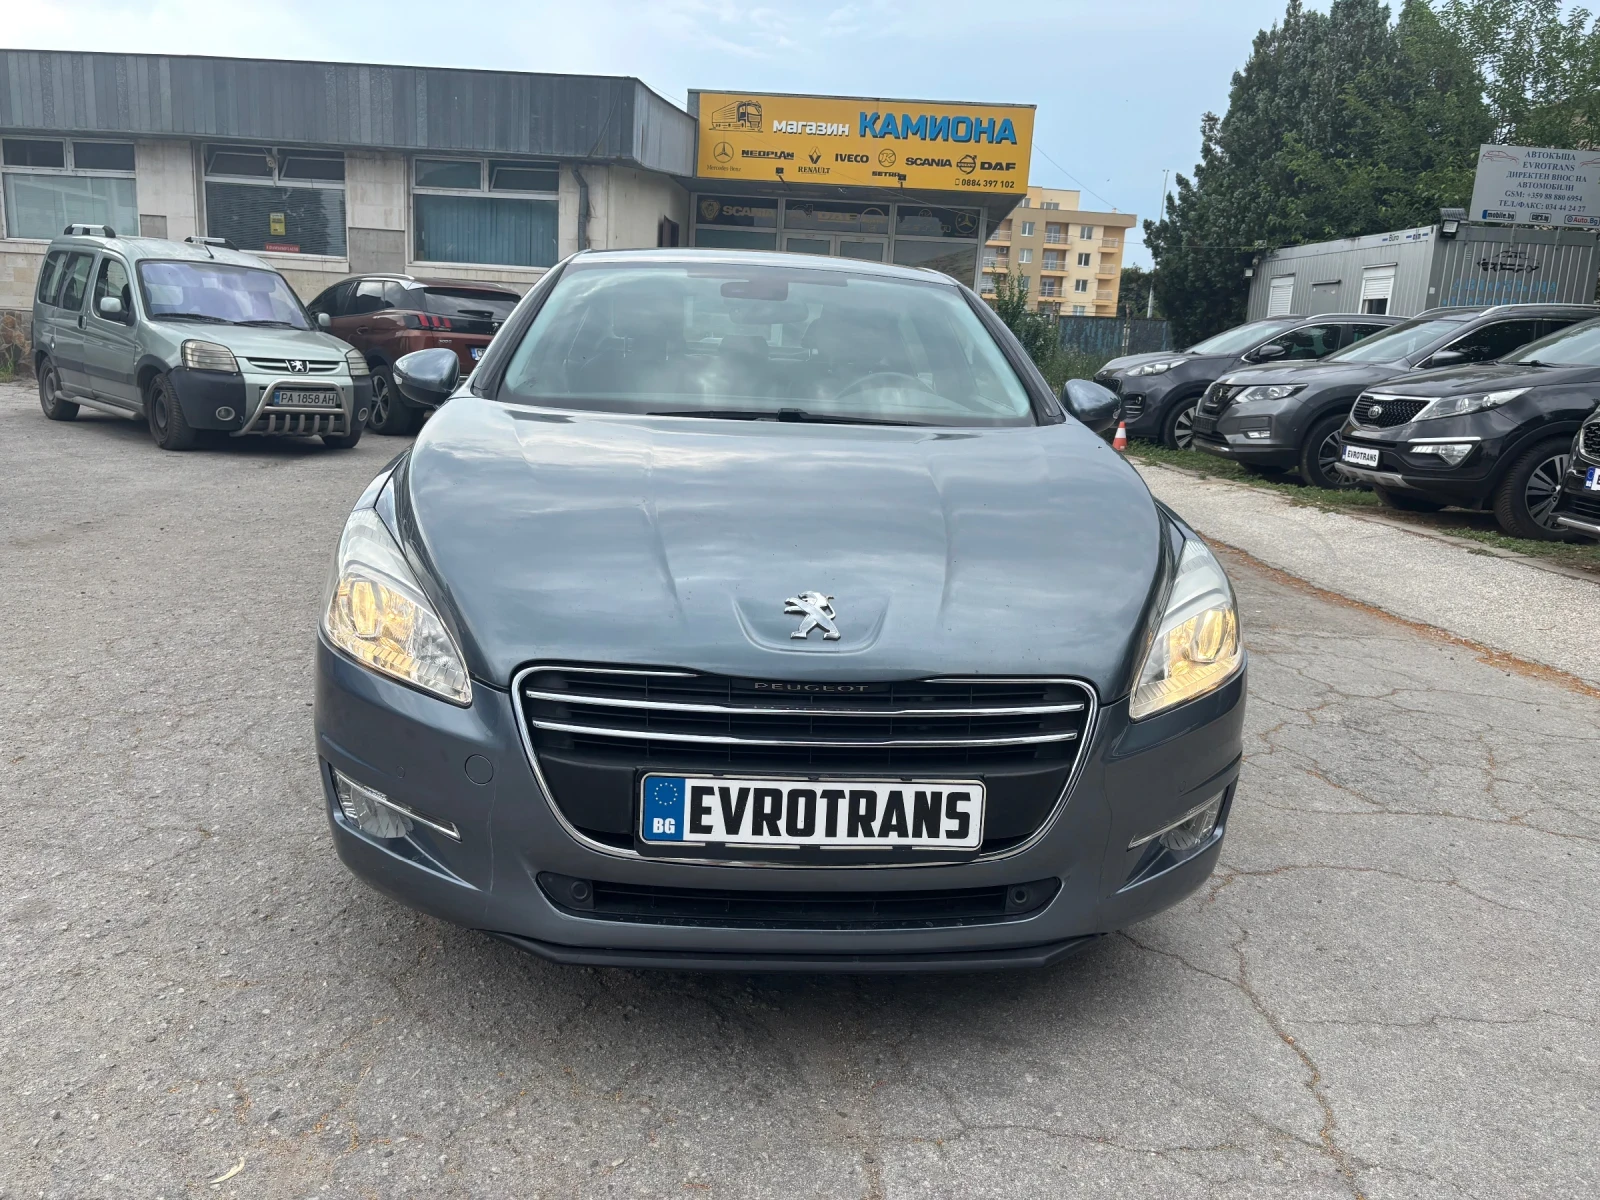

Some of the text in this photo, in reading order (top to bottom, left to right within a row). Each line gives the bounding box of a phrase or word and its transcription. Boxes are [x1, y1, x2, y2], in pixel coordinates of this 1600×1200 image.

[772, 111, 1018, 145] магазин КАМИОНА
[741, 149, 795, 160] NEOPLAN
[834, 152, 869, 164] IVECO
[1525, 150, 1576, 161] АВТОКЪЩА
[905, 156, 952, 168] SCANIA
[979, 161, 1016, 172] DAF
[1522, 161, 1576, 171] EVROTRANS
[797, 166, 831, 175] RENAULT
[1506, 171, 1550, 180] ДИРЕКТЕН
[1551, 173, 1574, 182] ВНОС
[961, 178, 1015, 189] 0884 397 102
[1517, 181, 1574, 191] АВТОМОБИЛИ
[1504, 190, 1525, 198] GSM:
[1577, 205, 1587, 213] 27
[1487, 210, 1515, 220] mobile.bg
[280, 392, 335, 405] PA 1858 AH
[1347, 450, 1377, 463] EVROTRANS
[754, 682, 869, 692] PEUGEOT
[652, 785, 972, 840] BG EVROTRANS
